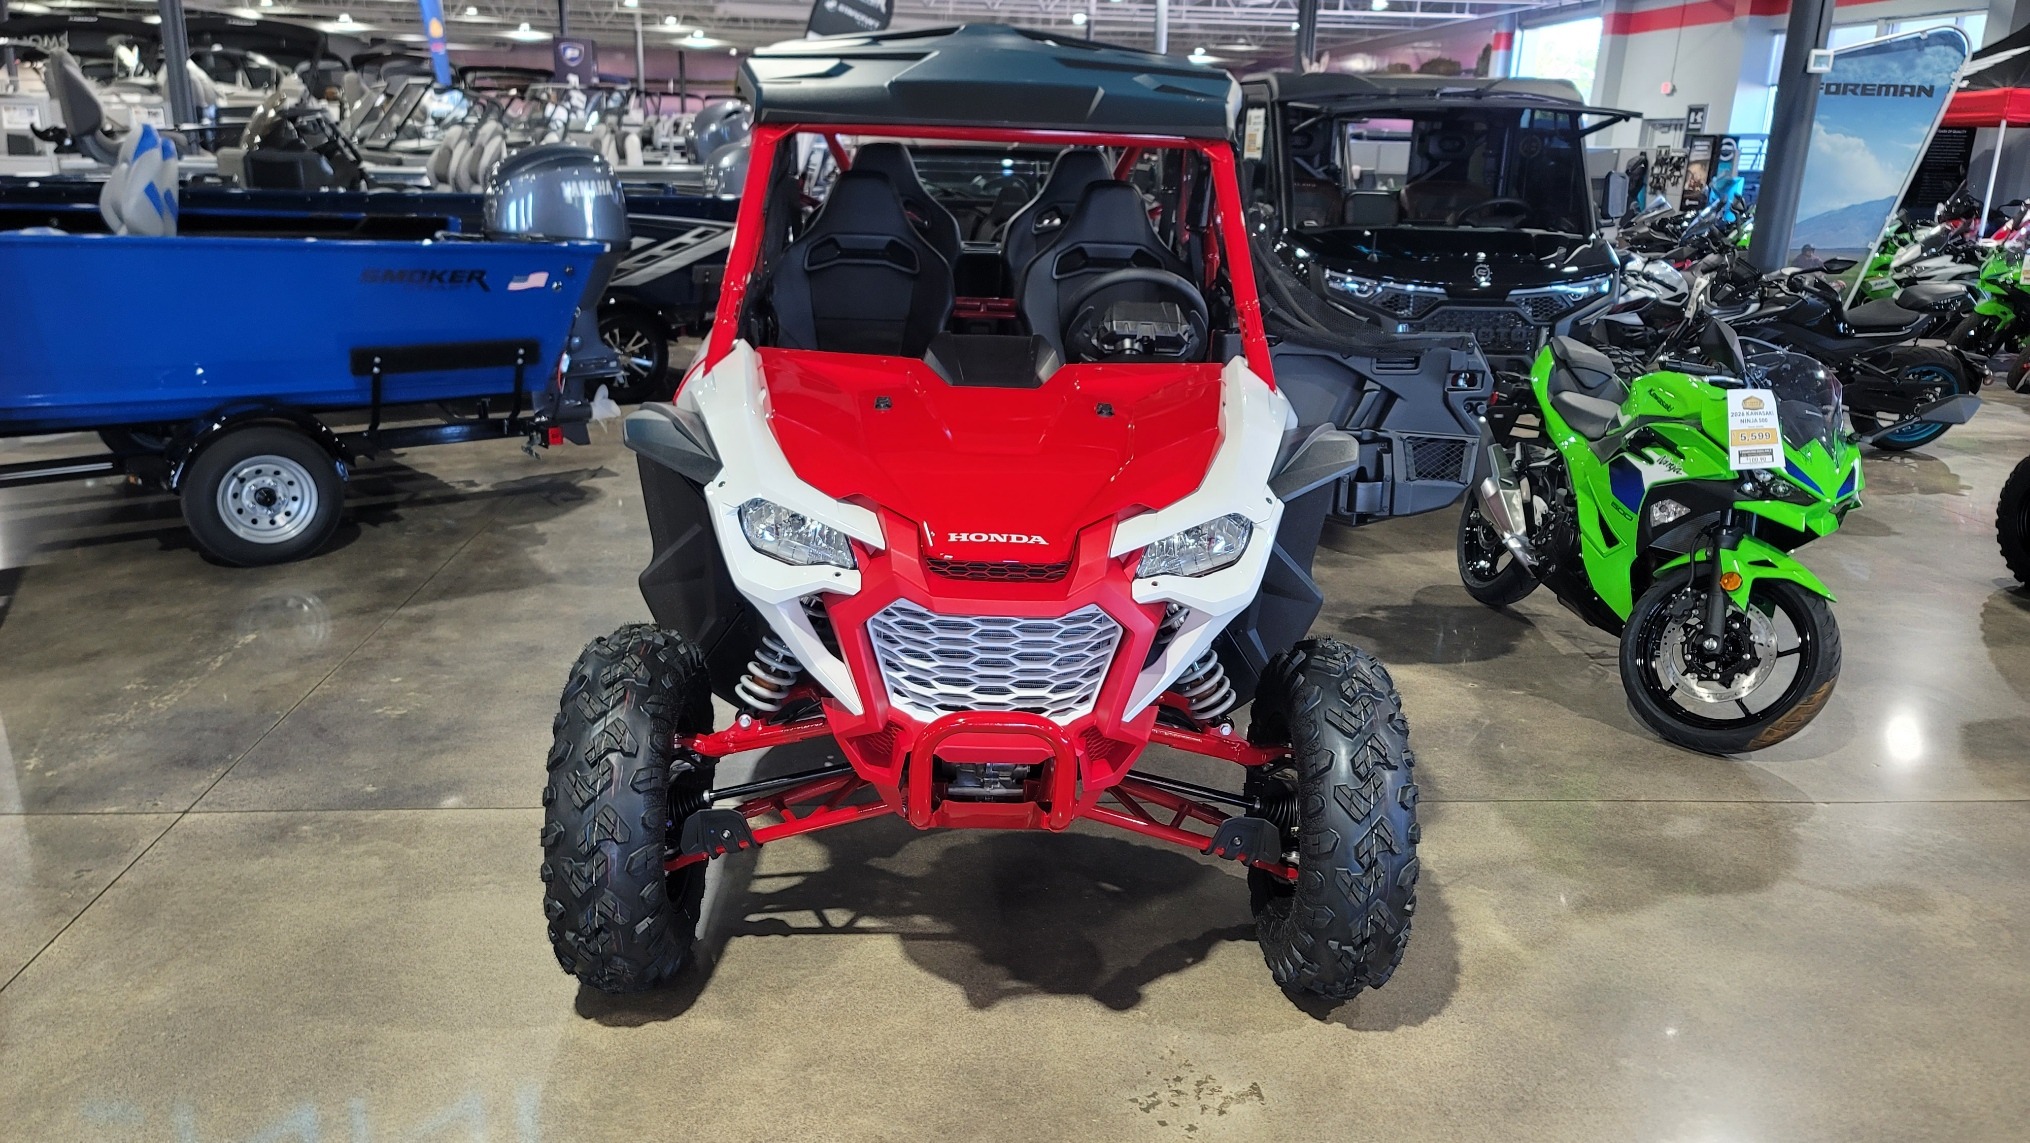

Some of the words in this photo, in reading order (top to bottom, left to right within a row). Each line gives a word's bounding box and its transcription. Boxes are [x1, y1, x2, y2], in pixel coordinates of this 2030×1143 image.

[561, 180, 613, 197] YAMAHA
[361, 268, 491, 292] SMOKER
[1648, 388, 1674, 412] Kawasaki
[1740, 432, 1771, 441] 5,599
[1657, 455, 1682, 475] Ninja
[1611, 501, 1633, 521] 500
[948, 533, 1050, 545] HONDA
